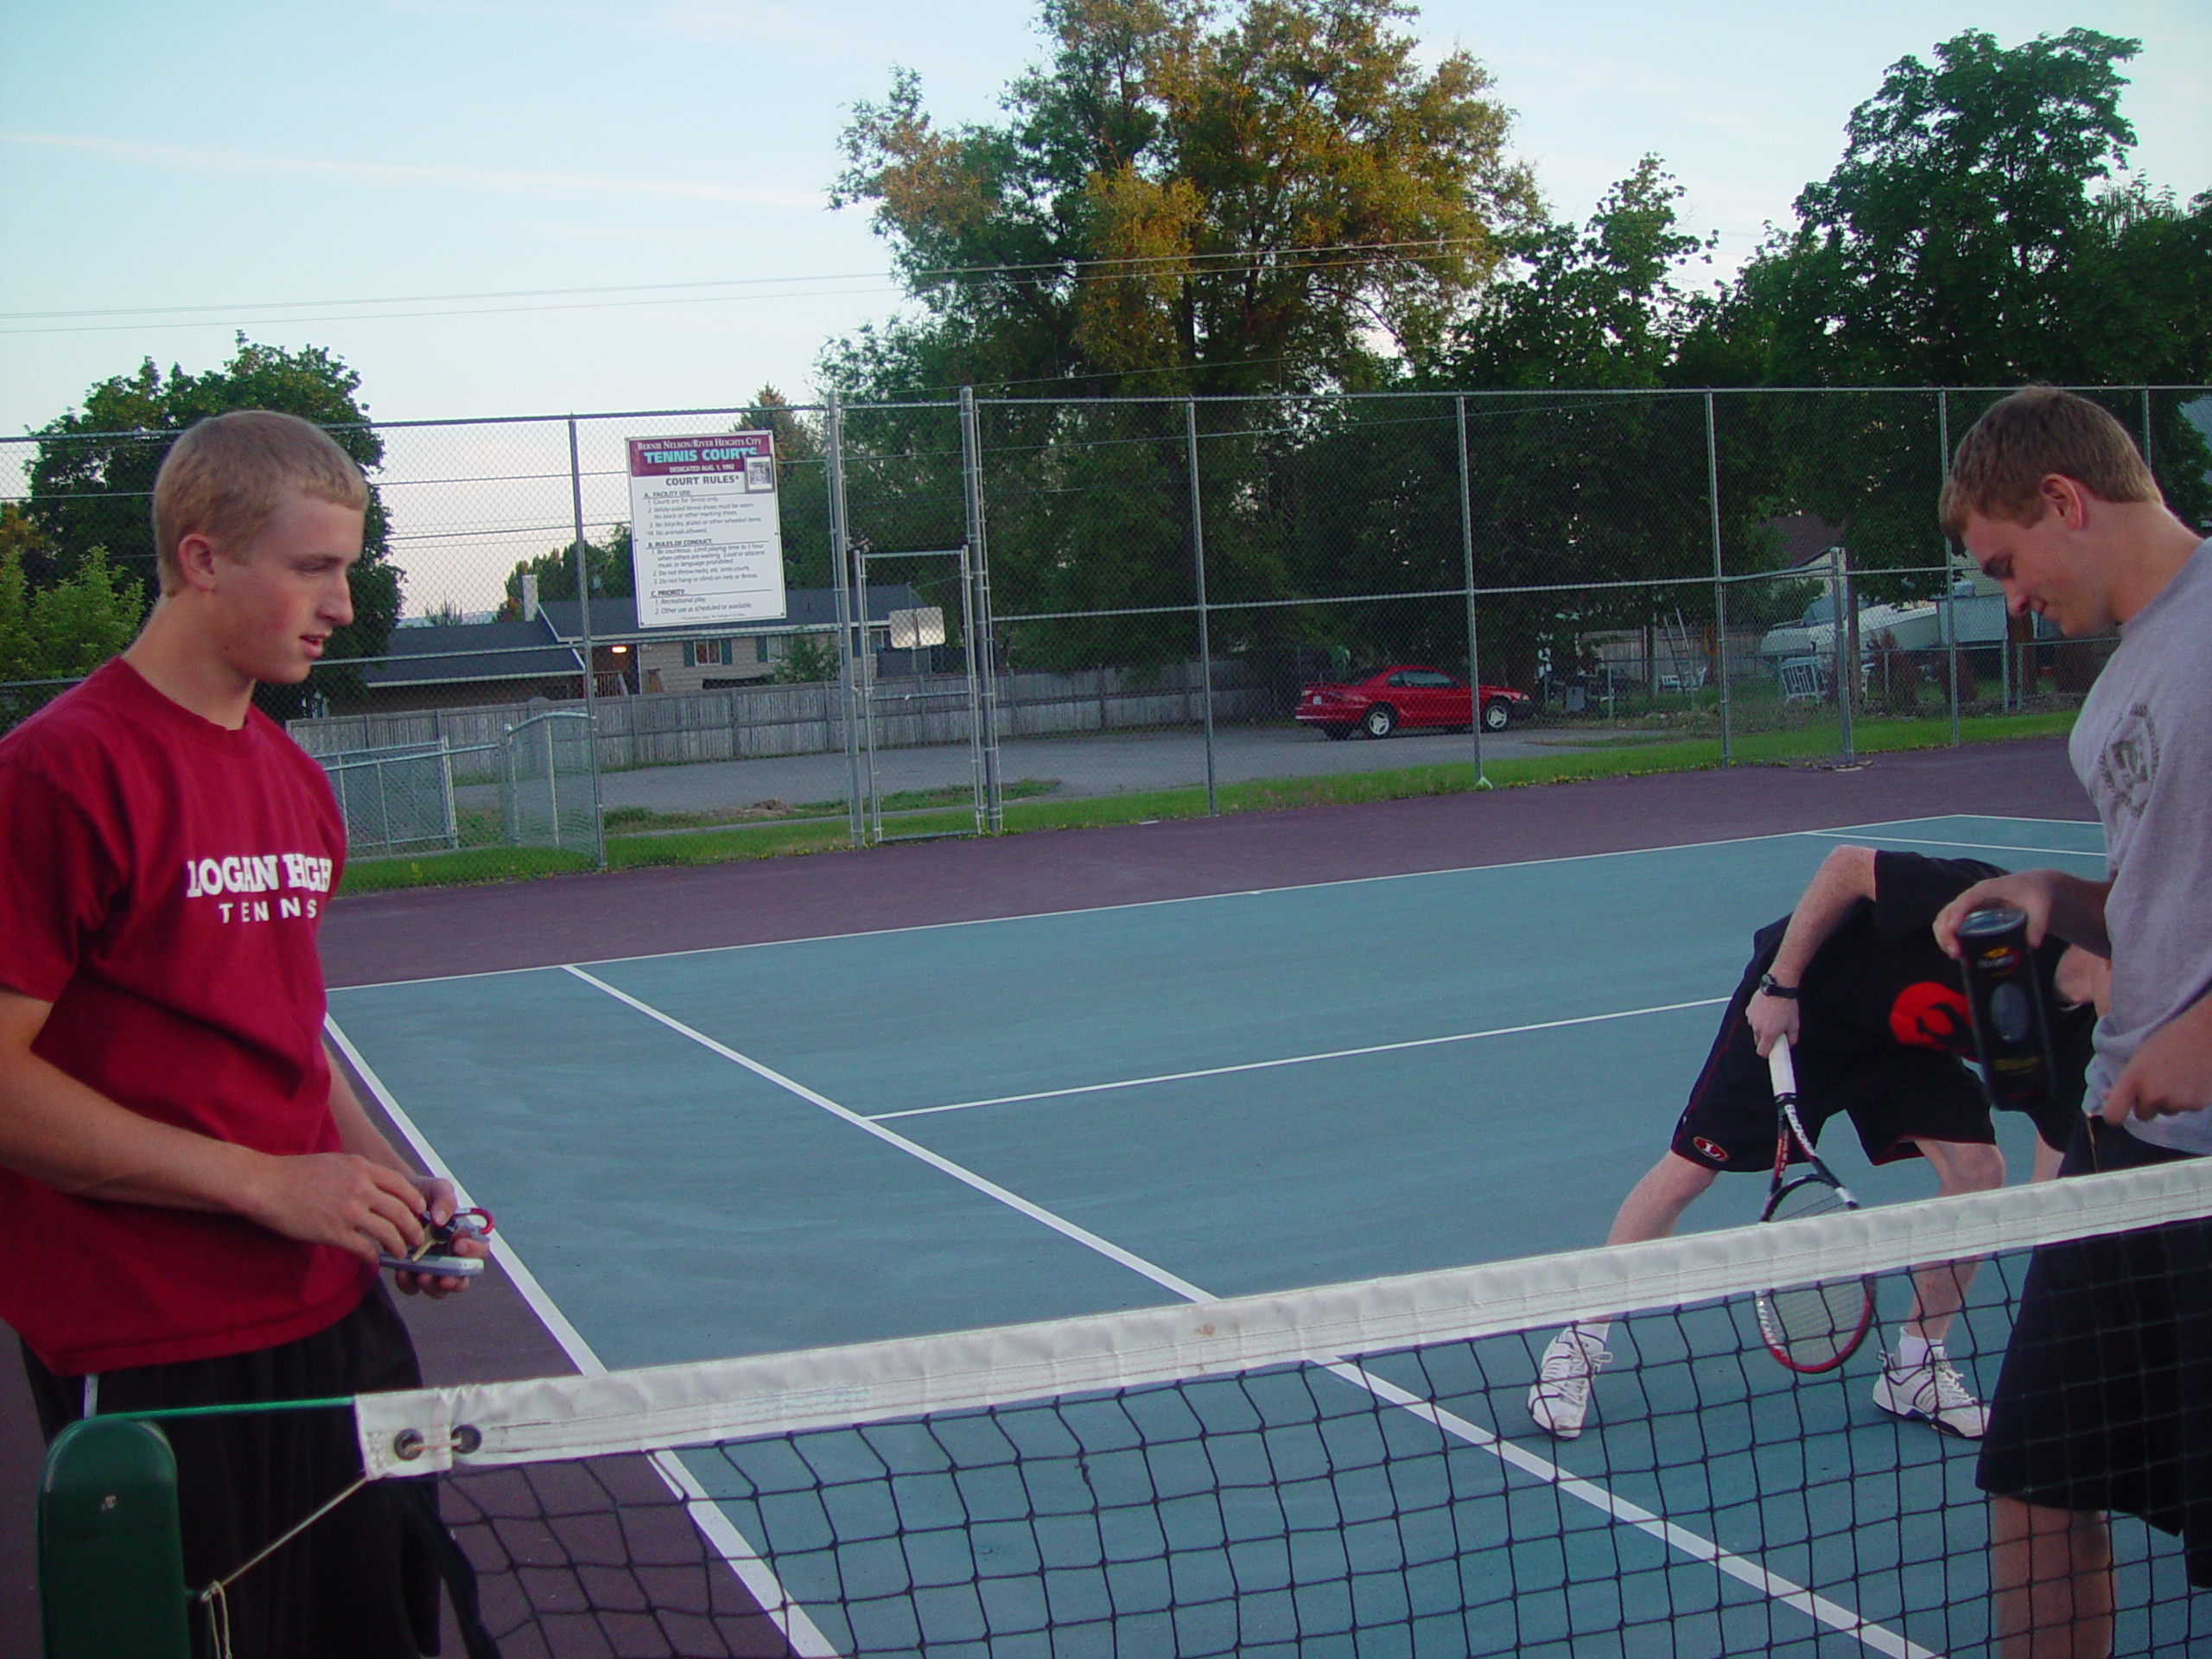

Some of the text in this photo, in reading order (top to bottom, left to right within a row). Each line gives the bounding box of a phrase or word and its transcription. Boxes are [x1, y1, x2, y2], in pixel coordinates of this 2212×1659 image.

[644, 447, 758, 464] TENNIS COURTS
[665, 476, 700, 486] COURT
[683, 537, 712, 546] CONDUCT
[187, 855, 280, 899] LOGAN
[218, 896, 318, 925] TENNS
